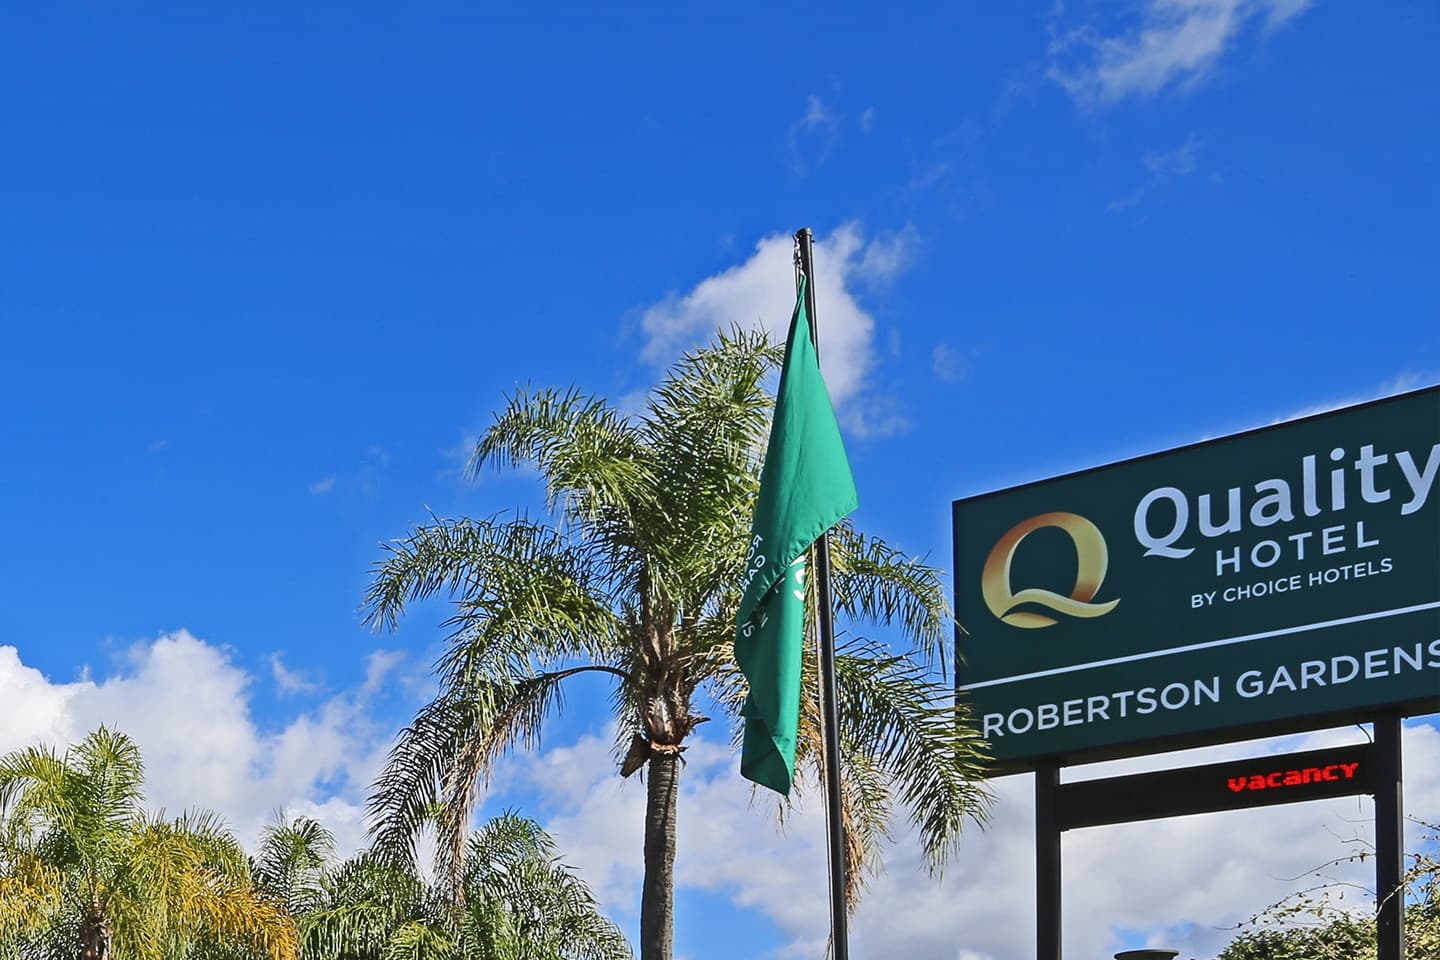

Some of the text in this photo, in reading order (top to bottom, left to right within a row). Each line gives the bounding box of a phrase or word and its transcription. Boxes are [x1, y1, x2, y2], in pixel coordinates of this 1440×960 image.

[1133, 442, 1440, 559] Quality
[1215, 520, 1380, 577] HOTEL
[1190, 557, 1394, 609] BY CHOICE HOTELS
[982, 639, 1440, 739] ROBERTSON GARDENS
[1227, 761, 1360, 793] vacancy
